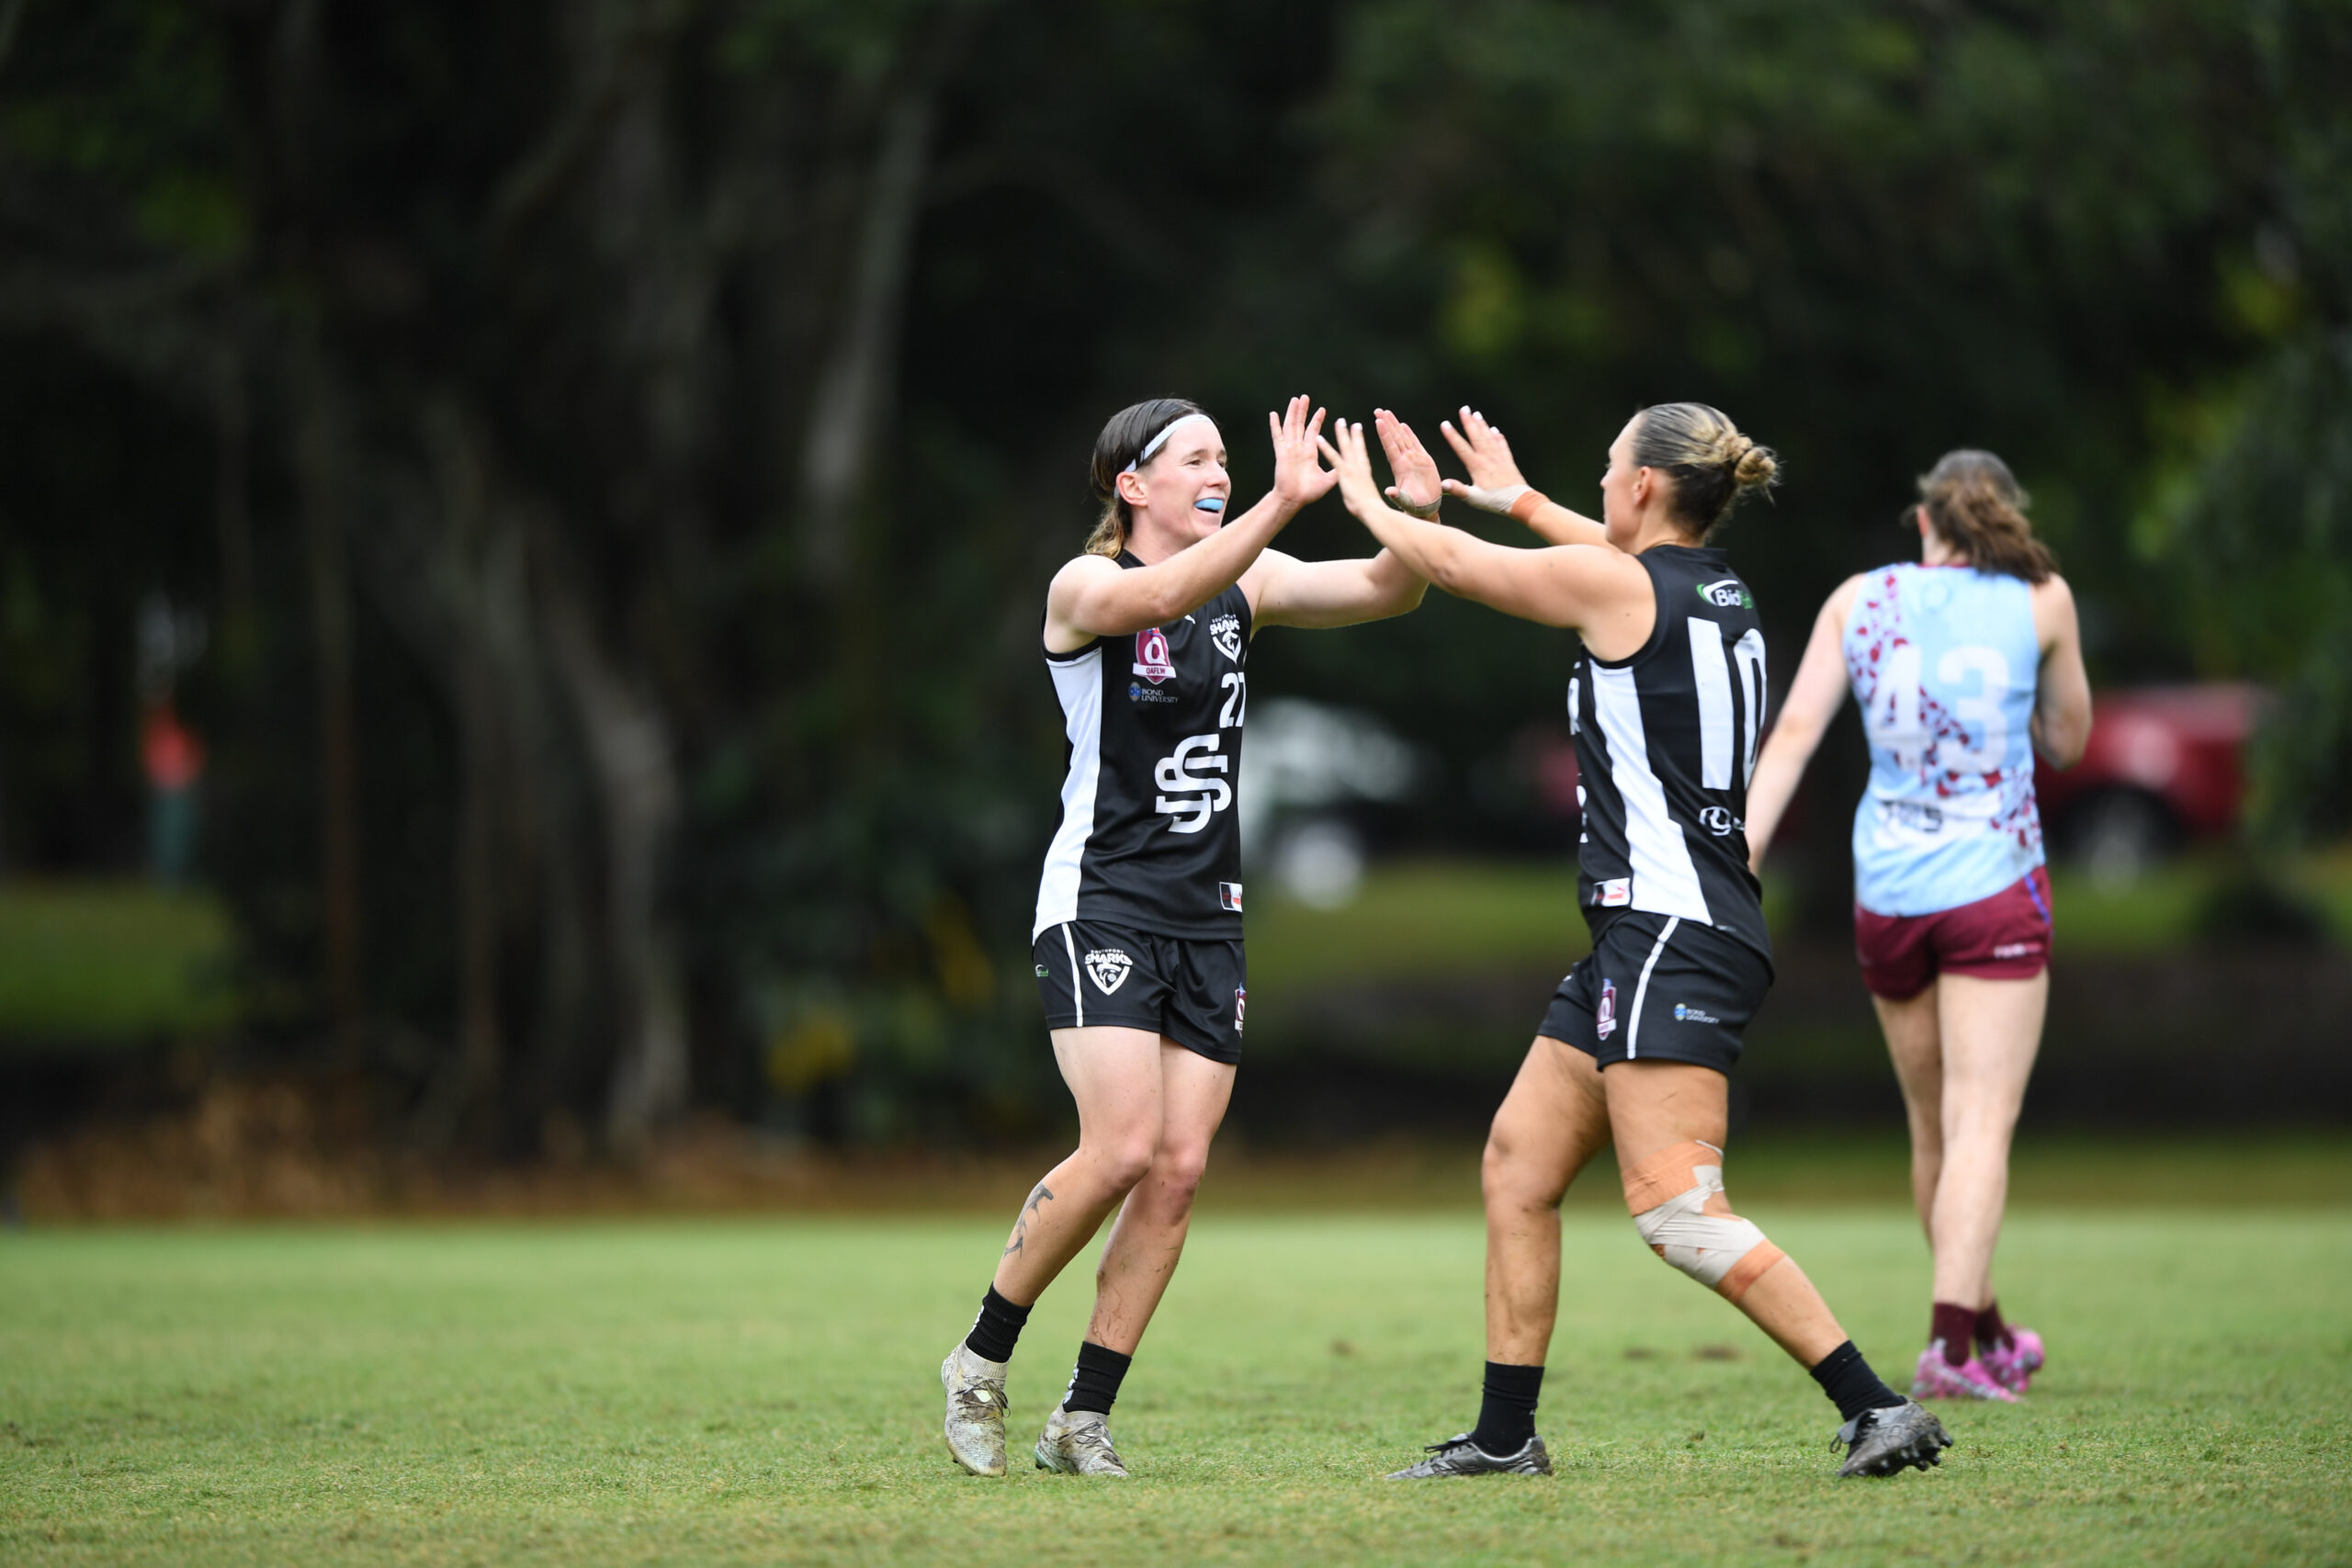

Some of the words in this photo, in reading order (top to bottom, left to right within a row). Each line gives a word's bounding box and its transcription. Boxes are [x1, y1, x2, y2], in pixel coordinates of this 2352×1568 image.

[1219, 671, 1246, 728] 27
[1688, 616, 1767, 791] 10
[1869, 645, 2009, 775] 43
[1084, 953, 1133, 965] SHARKS
